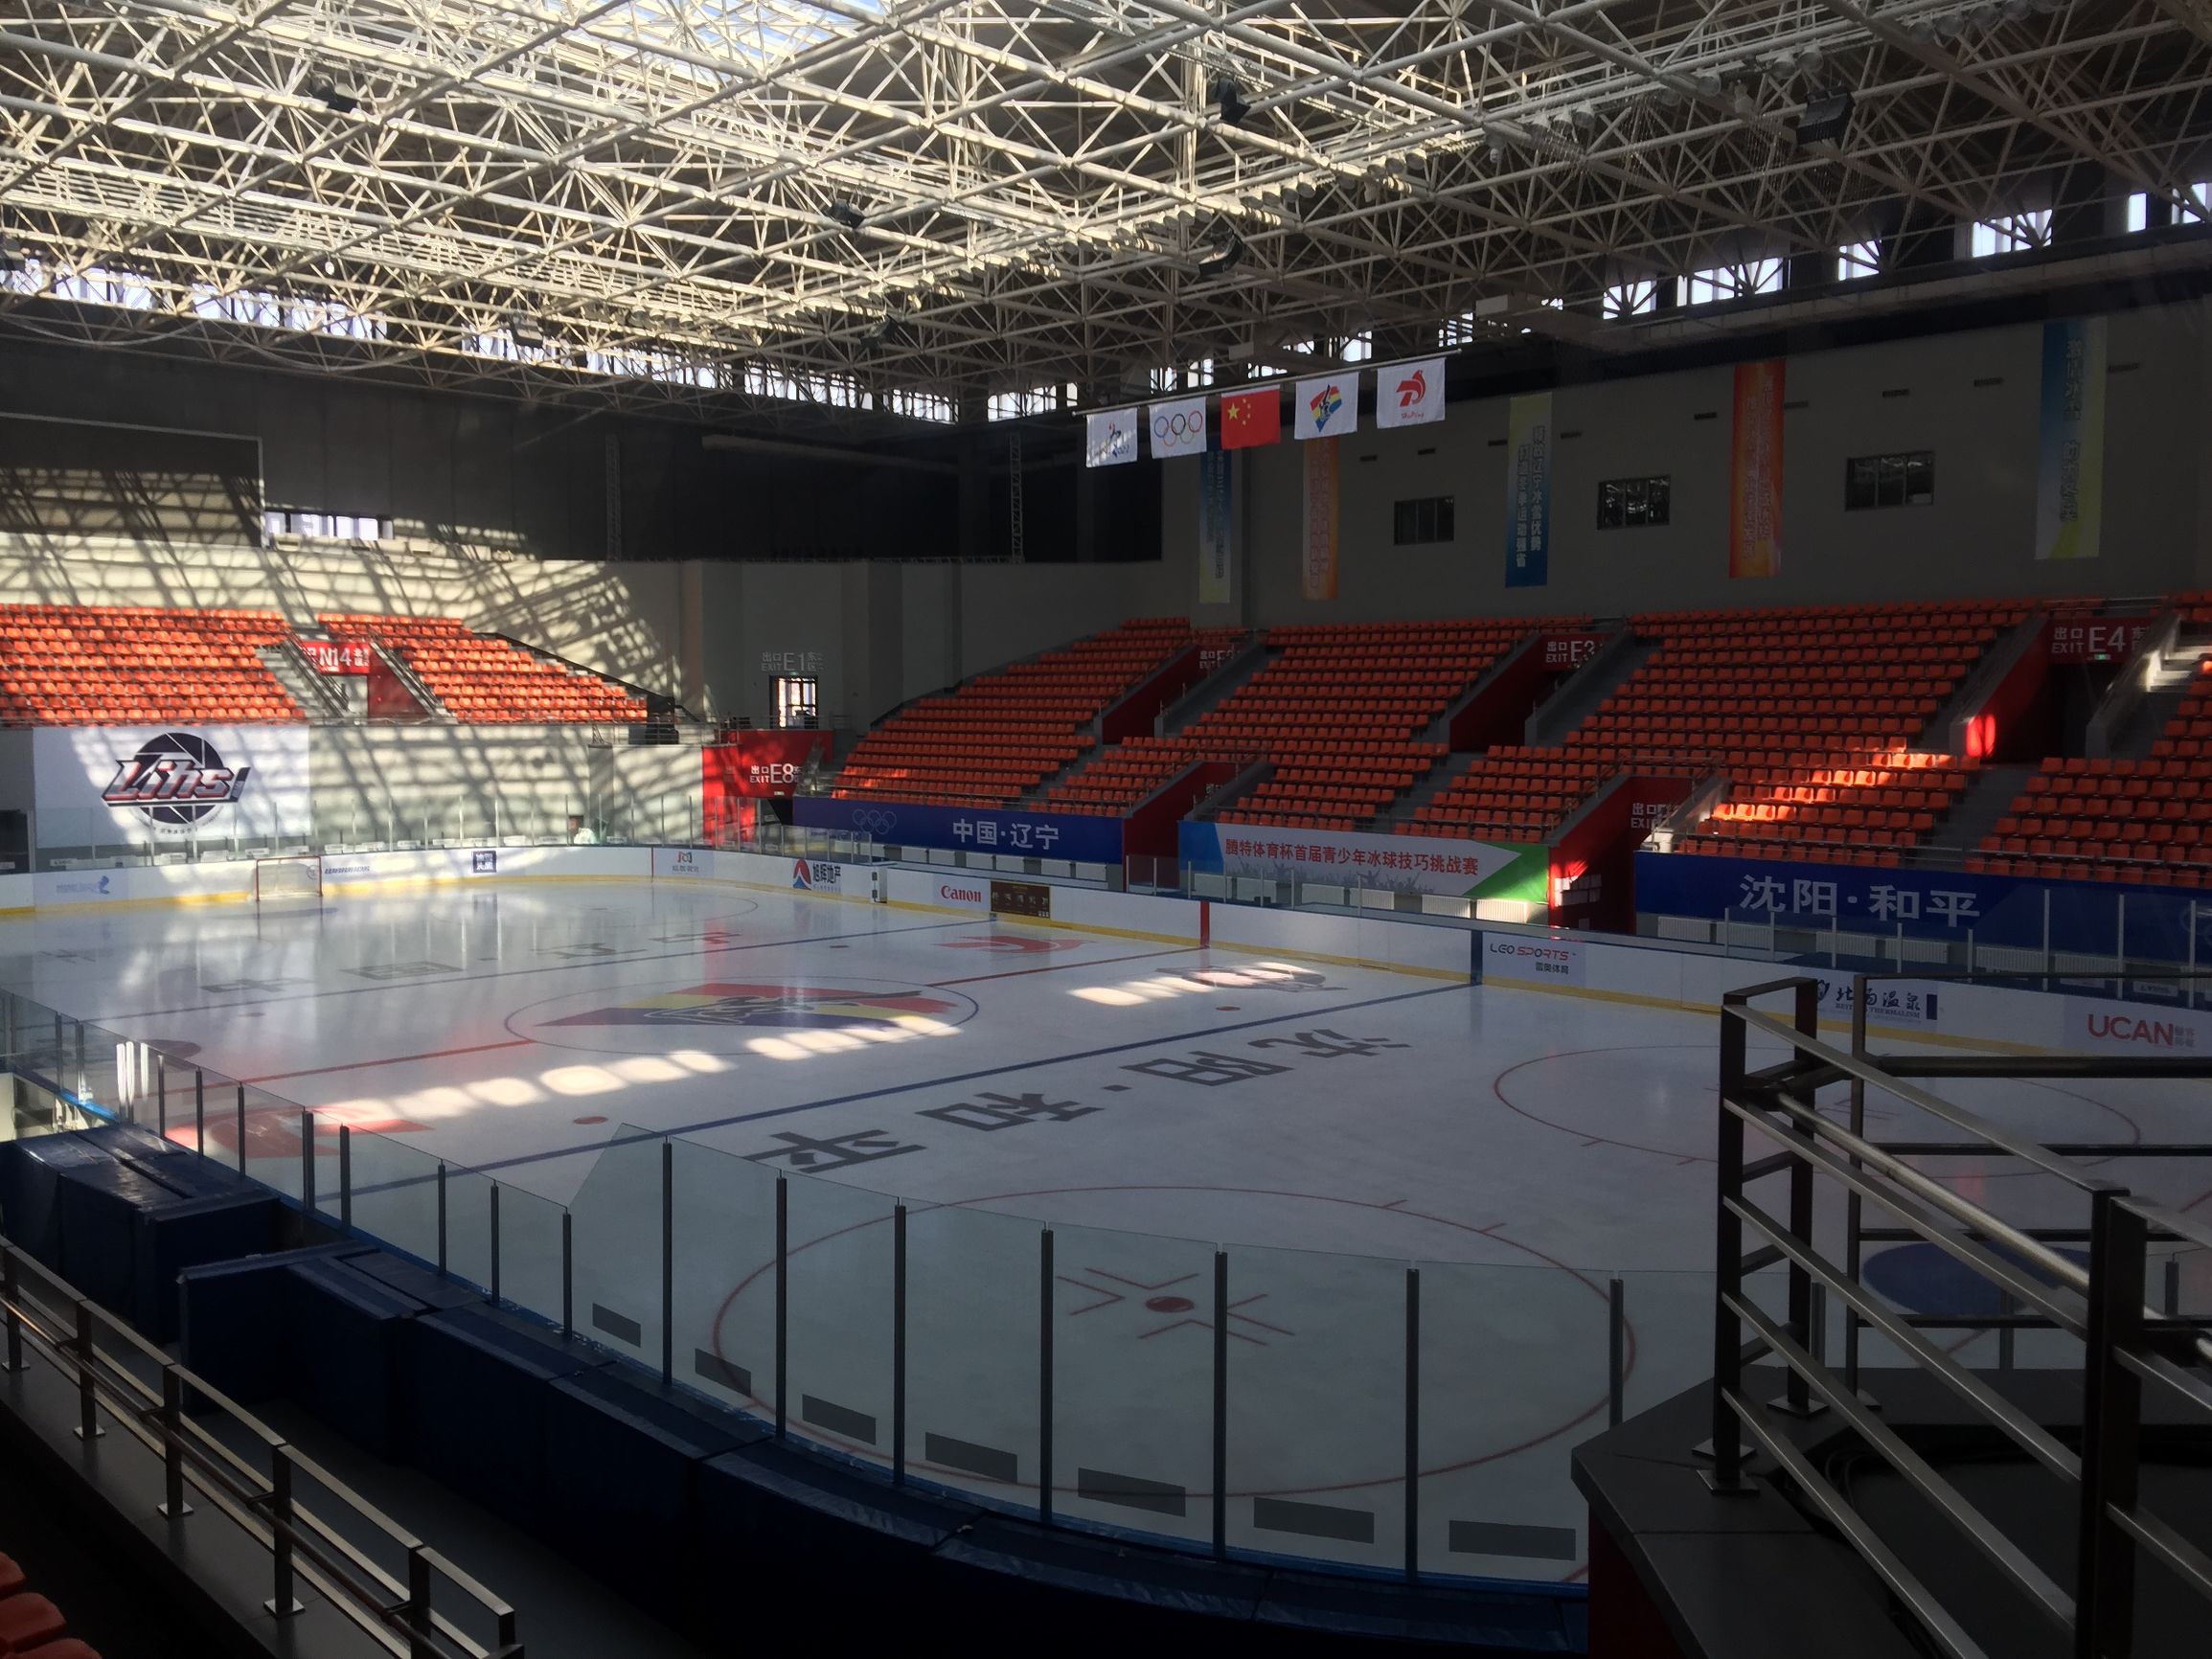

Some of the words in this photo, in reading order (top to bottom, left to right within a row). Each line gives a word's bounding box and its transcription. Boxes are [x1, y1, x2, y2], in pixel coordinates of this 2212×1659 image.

[1547, 641, 1567, 652] 出口
[2052, 642, 2085, 653] EXIT
[2054, 626, 2084, 640] 出口
[2087, 625, 2127, 652] E4
[319, 647, 353, 667] N14
[762, 651, 782, 662] 出口
[784, 652, 805, 671] E1
[1545, 653, 1568, 663] EXIT
[761, 663, 782, 671] EXIT
[750, 775, 770, 784] EXIT
[751, 764, 769, 775] 出口
[770, 762, 794, 784] E8
[1632, 803, 1656, 815] 出口
[953, 818, 1059, 851] 中国·辽宁
[941, 885, 982, 903] Canon
[1739, 874, 1981, 928] 沈阳·和平
[1490, 943, 1515, 955] LEO
[1516, 946, 1569, 961] SPORTS
[2087, 1013, 2174, 1045] UCAN
